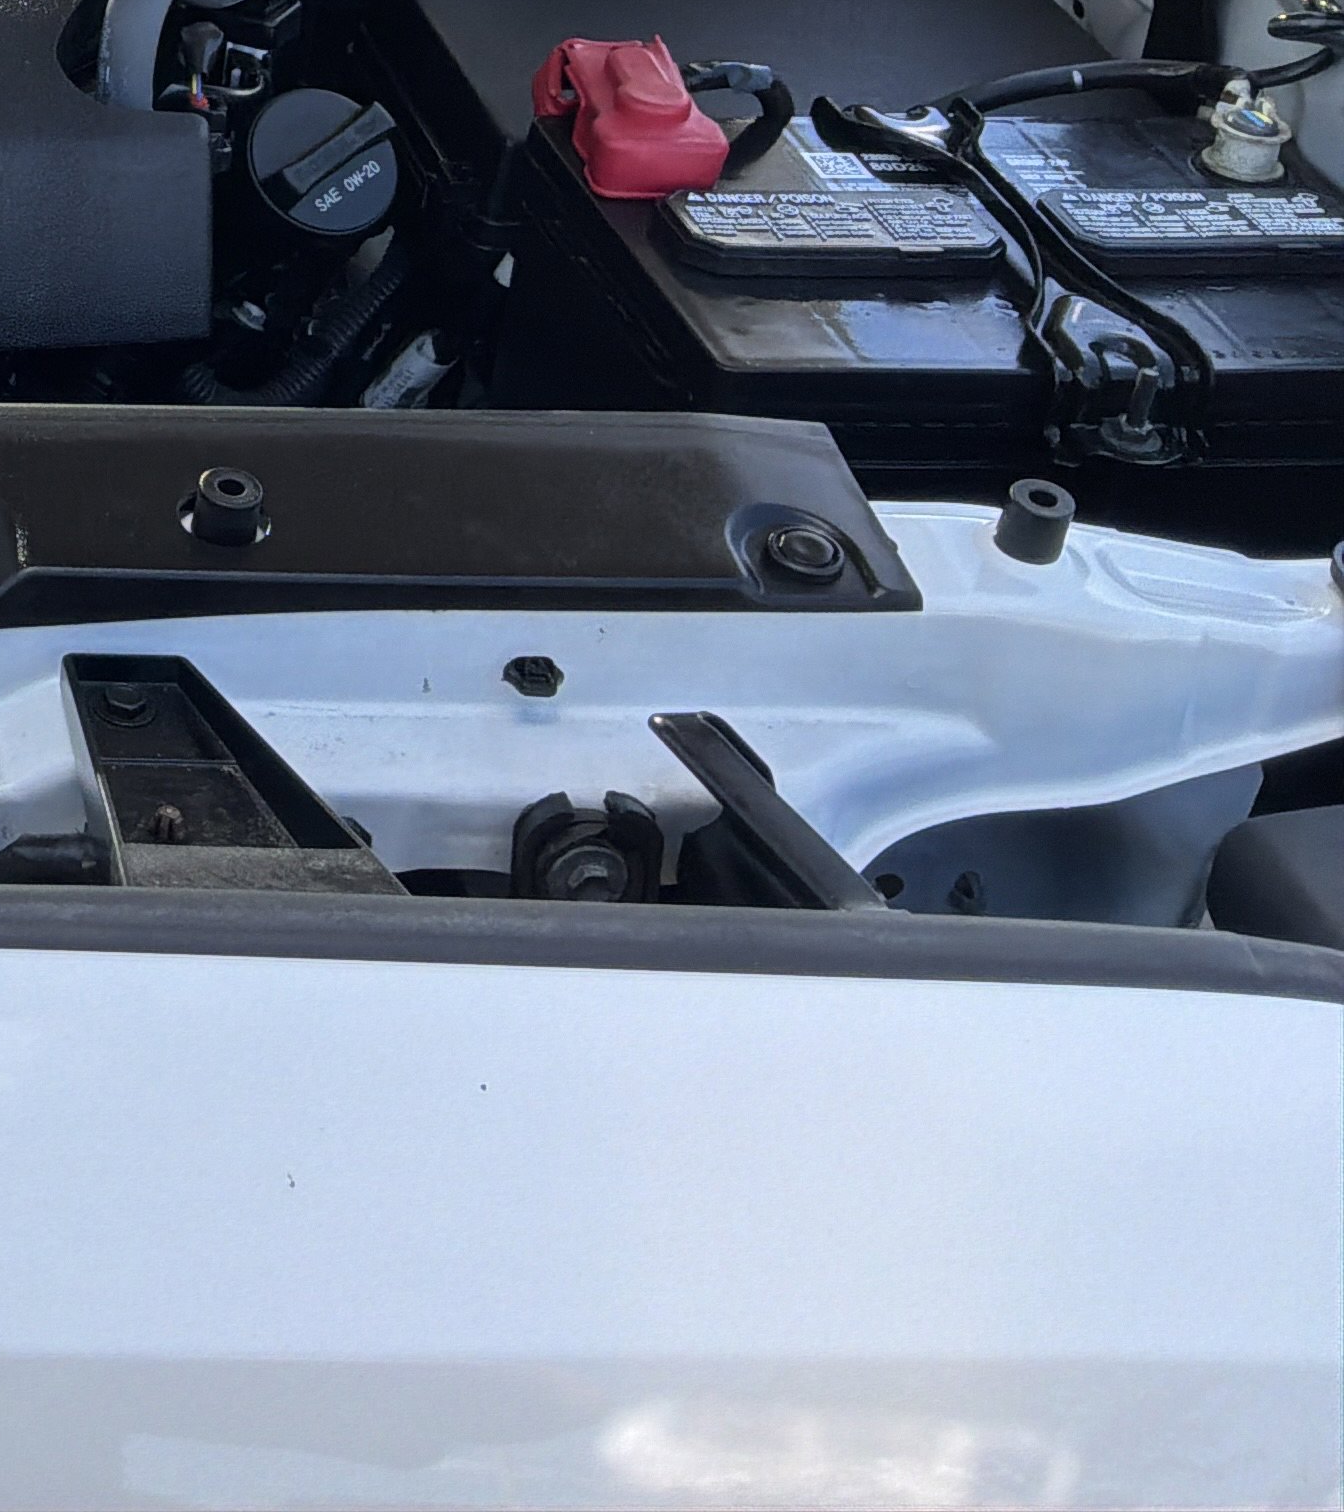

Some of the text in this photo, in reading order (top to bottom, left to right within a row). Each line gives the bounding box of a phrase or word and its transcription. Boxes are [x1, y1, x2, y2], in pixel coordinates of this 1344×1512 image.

[314, 160, 381, 213] SAE 0W-20
[705, 192, 767, 205] DANGER
[779, 193, 836, 205] POISON
[1079, 192, 1141, 203] DANGER
[1149, 192, 1207, 203] POISON
